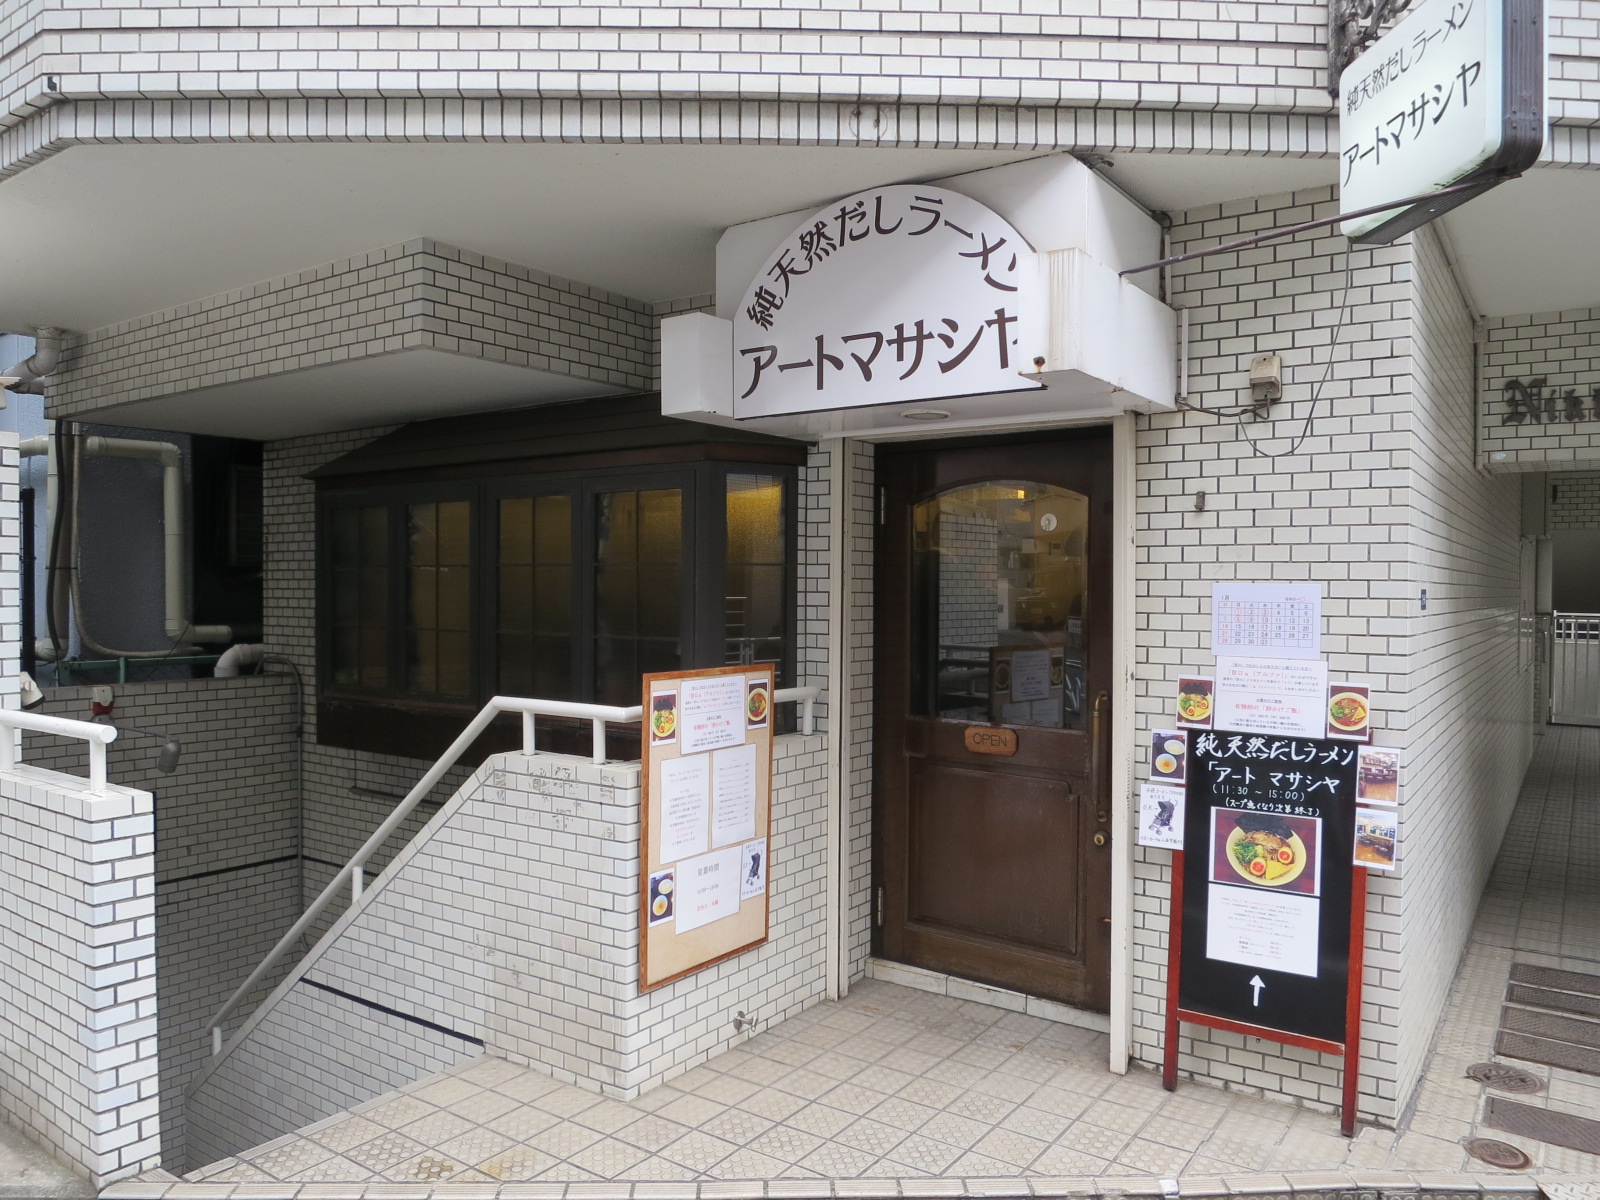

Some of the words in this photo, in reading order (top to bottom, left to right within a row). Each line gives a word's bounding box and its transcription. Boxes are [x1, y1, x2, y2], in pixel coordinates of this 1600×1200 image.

[1347, 0, 1473, 116] 純天然だしラーメン
[1343, 61, 1481, 188] アートマサシヤ
[973, 733, 1007, 748] OPEN
[1196, 732, 1354, 766] 純天然だしラーメン
[1270, 772, 1340, 794] マサシヤ
[698, 863, 719, 877] 営業時間
